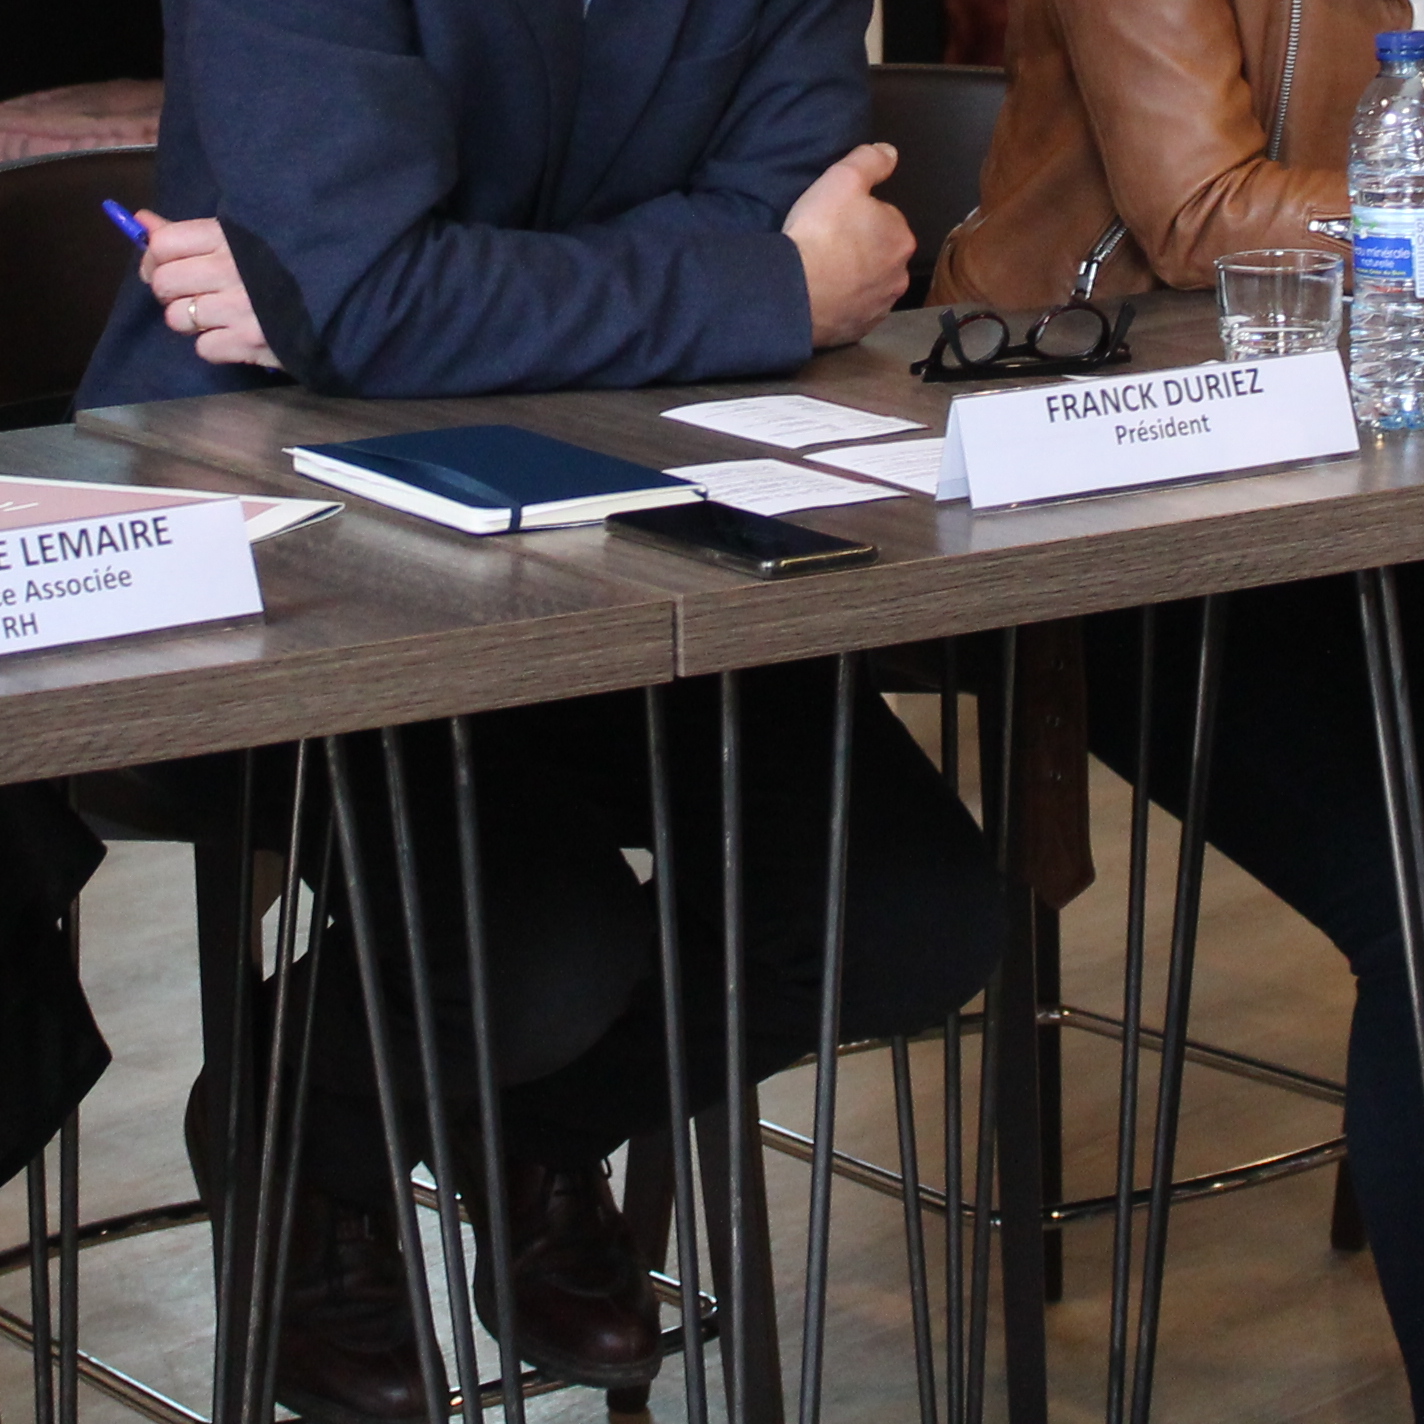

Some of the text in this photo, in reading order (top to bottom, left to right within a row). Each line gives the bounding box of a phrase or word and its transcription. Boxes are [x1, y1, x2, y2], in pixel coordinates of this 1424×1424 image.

[1366, 245, 1410, 259] minérale
[1046, 368, 1264, 423] FRANCK DURIEZ
[1115, 414, 1211, 445] Président
[21, 516, 173, 567] LEMAIRE
[25, 566, 133, 603] Associée
[2, 613, 39, 639] RH
